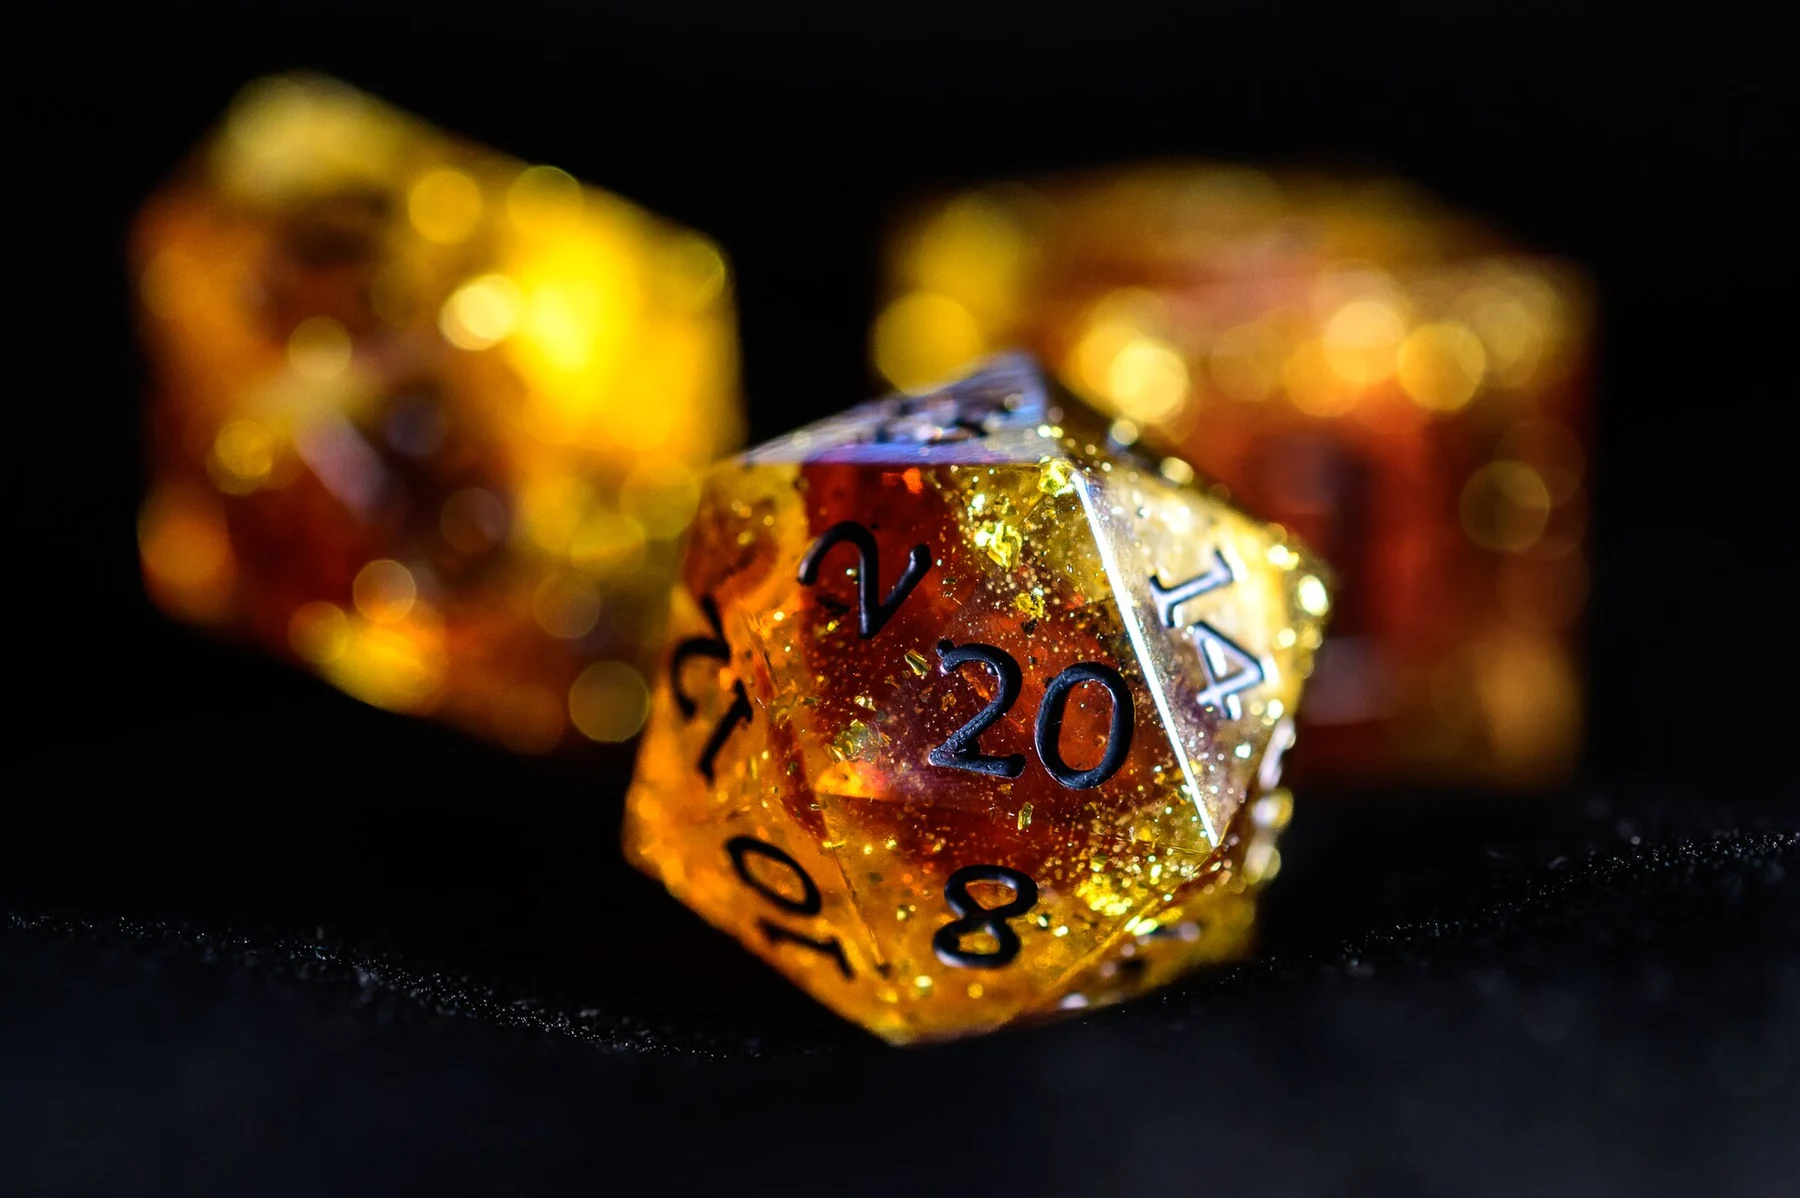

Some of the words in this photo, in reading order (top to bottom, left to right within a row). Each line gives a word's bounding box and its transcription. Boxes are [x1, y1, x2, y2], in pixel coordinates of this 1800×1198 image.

[797, 521, 932, 640] 2
[1149, 547, 1266, 721] 14
[670, 593, 754, 786] 12
[928, 639, 1136, 790] 20
[725, 836, 856, 981] 10
[932, 864, 1039, 969] 8
